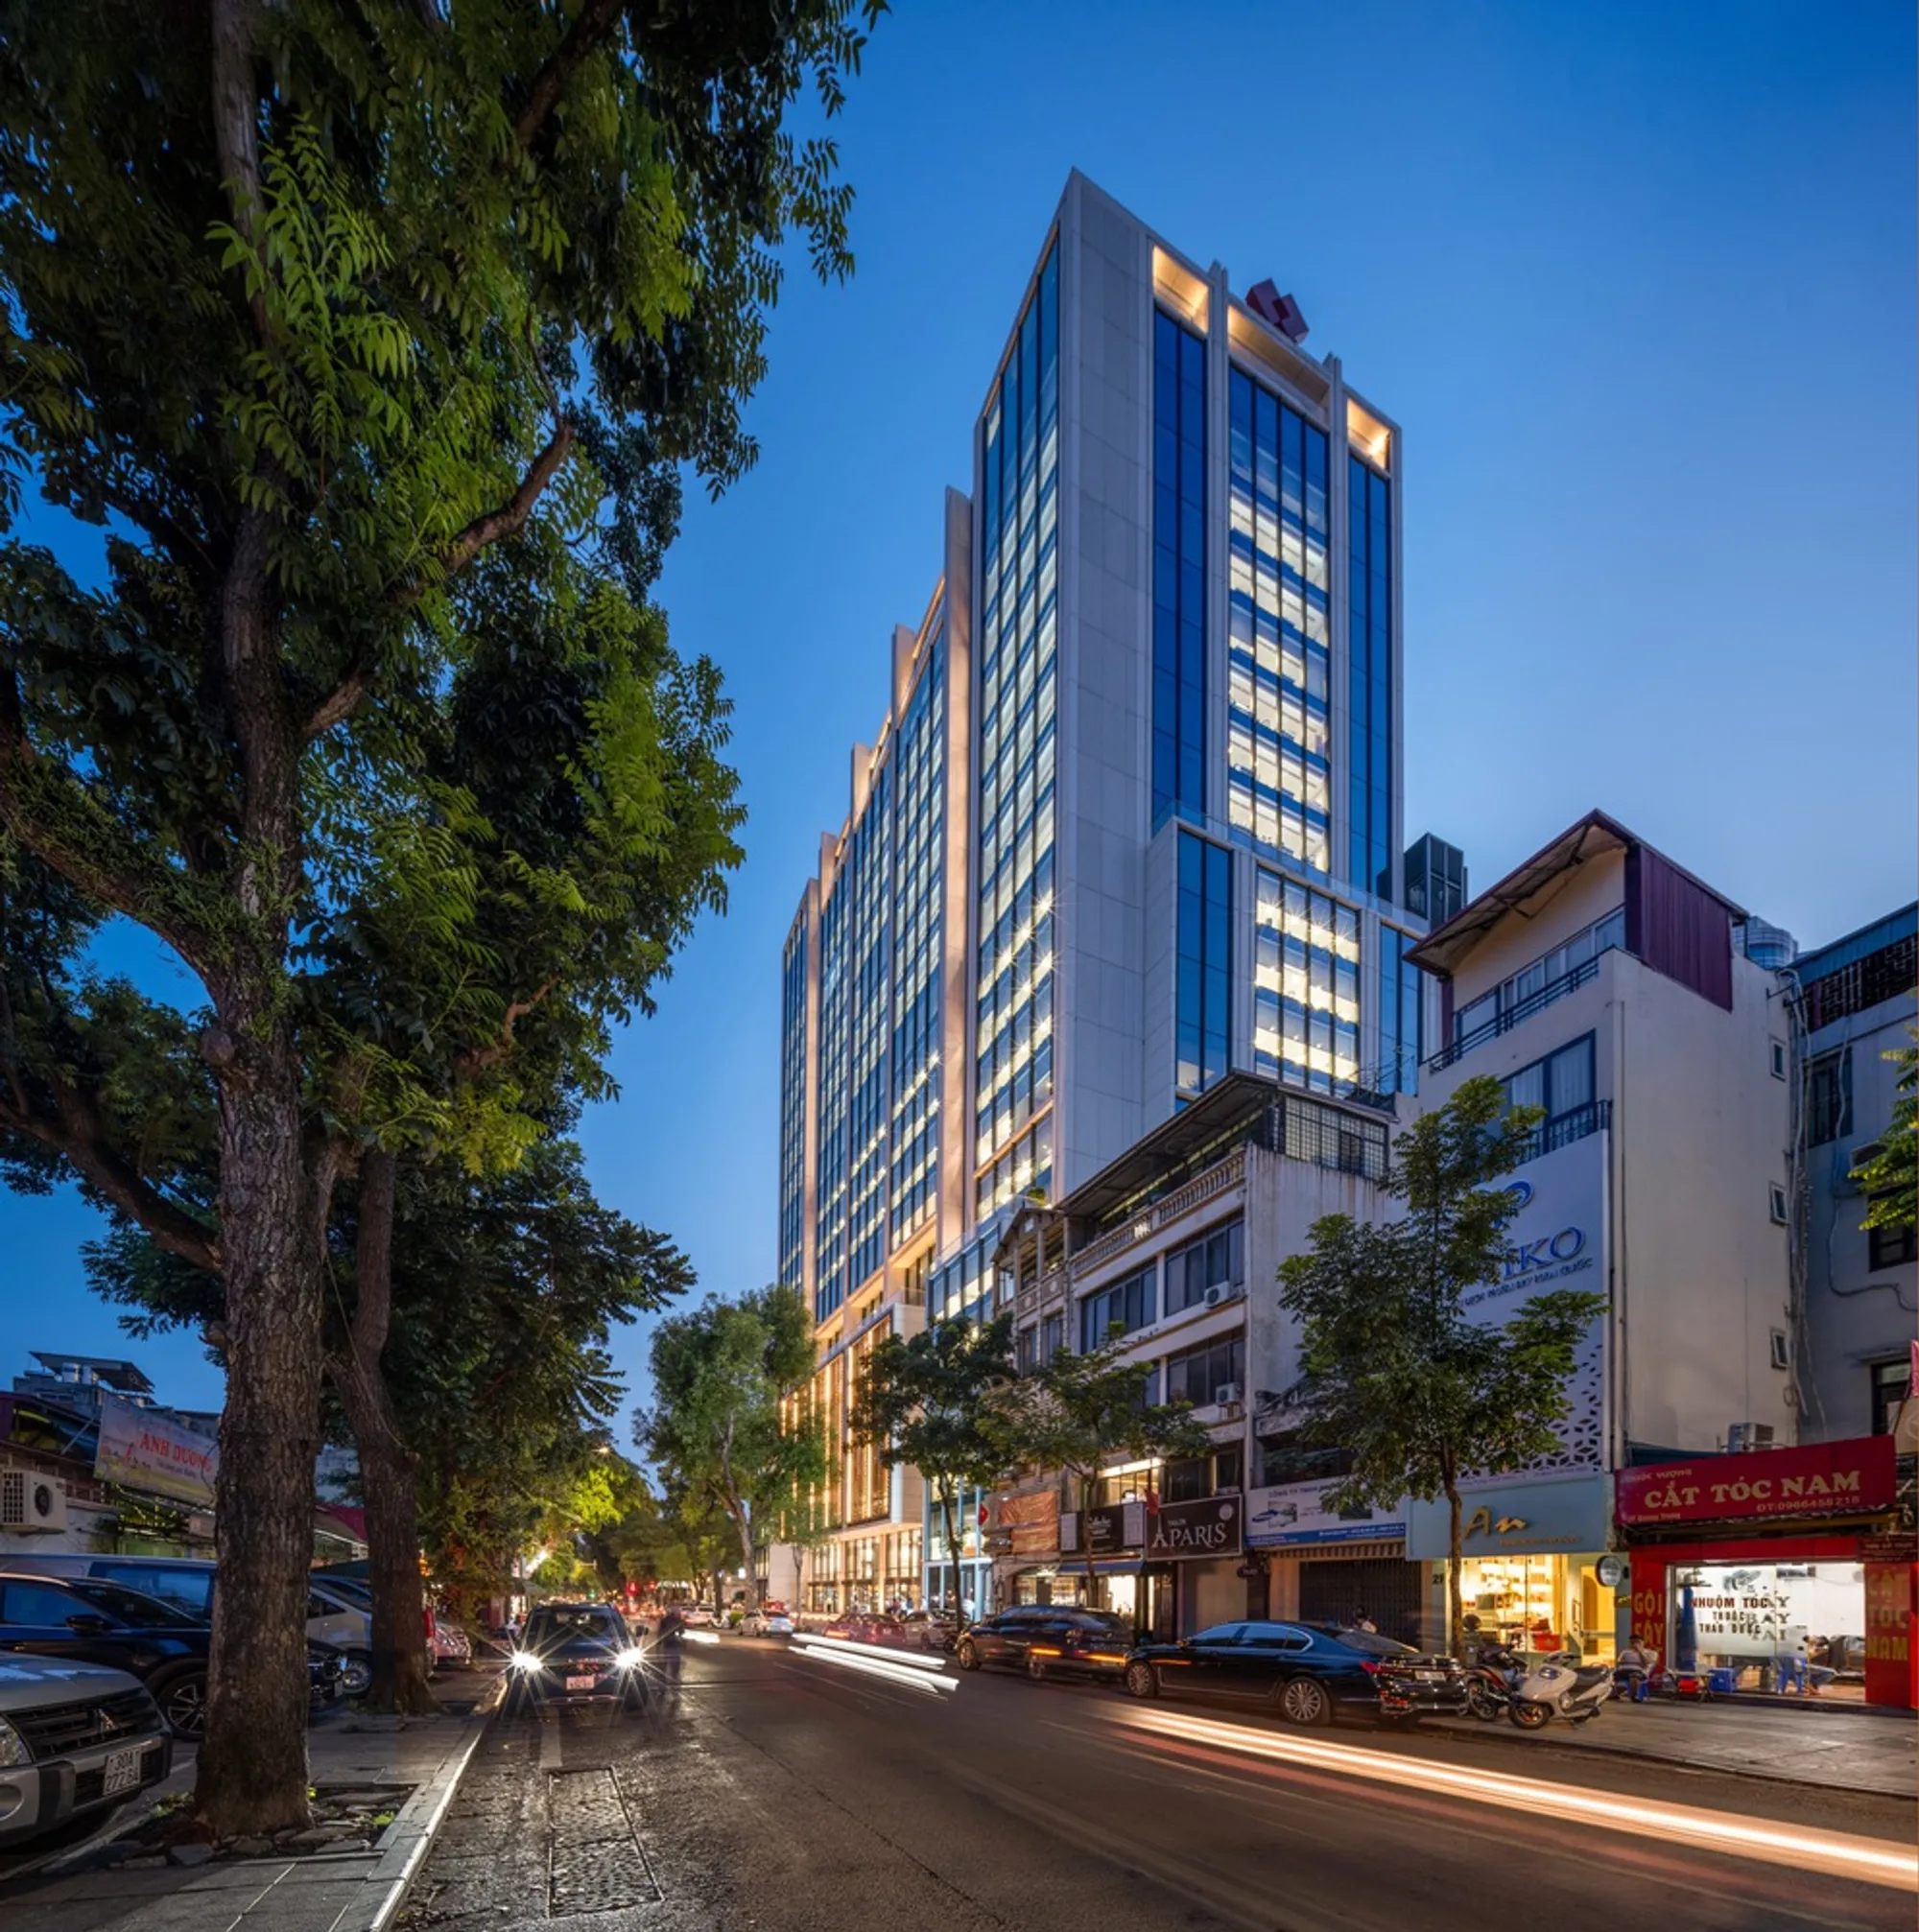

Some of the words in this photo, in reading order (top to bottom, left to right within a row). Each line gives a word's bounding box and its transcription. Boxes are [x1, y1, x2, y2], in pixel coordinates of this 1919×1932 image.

[1644, 1480, 1700, 1509] CẮT
[1711, 1476, 1771, 1503] TÓC
[1781, 1471, 1860, 1497] NAM
